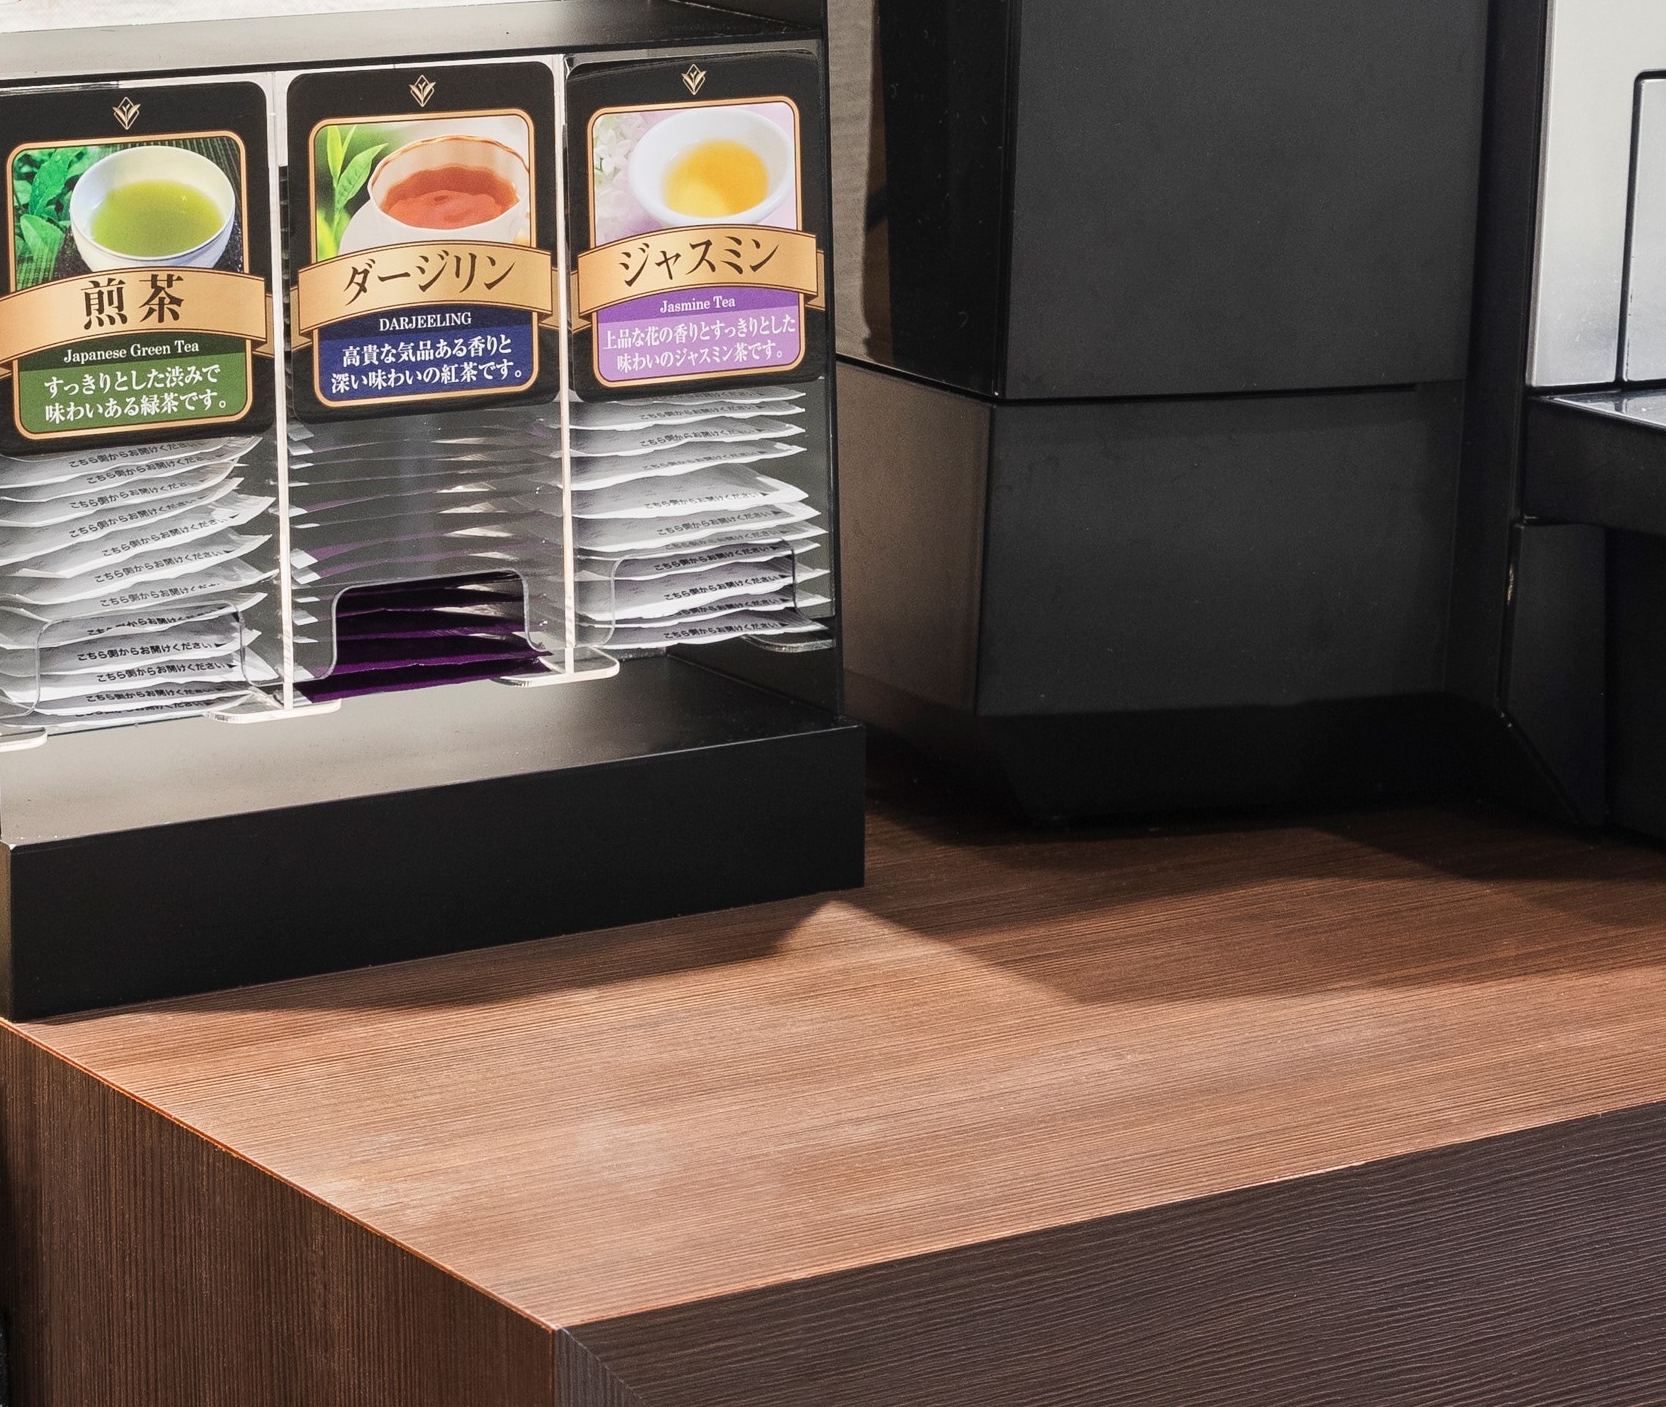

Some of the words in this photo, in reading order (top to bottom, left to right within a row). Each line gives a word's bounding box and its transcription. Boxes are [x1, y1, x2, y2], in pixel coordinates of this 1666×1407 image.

[343, 249, 516, 306] ダージリン
[619, 235, 780, 287] ジャスミン
[81, 273, 185, 330] 煎茶
[659, 298, 711, 314] Jasmine
[713, 296, 736, 309] Tea
[379, 312, 472, 332] DARJEELING
[603, 313, 797, 351] 上品な花の香りとすっきりとした
[63, 346, 127, 364] Japanese
[130, 342, 171, 358] Green
[174, 340, 199, 354] Tea
[342, 334, 512, 368] 高貴な気品ある香りと
[617, 342, 784, 374] 味わいのジャスミン茶です。
[45, 364, 221, 398] すっきりとした渋みで
[331, 360, 523, 394] 深い味わいの紅茶です。
[45, 390, 227, 424] 味わいある緑茶です。
[95, 550, 223, 584] こちら側からお開けください
[77, 642, 211, 662] こちら側からお開けください
[97, 662, 227, 682] こちら側からお開けください
